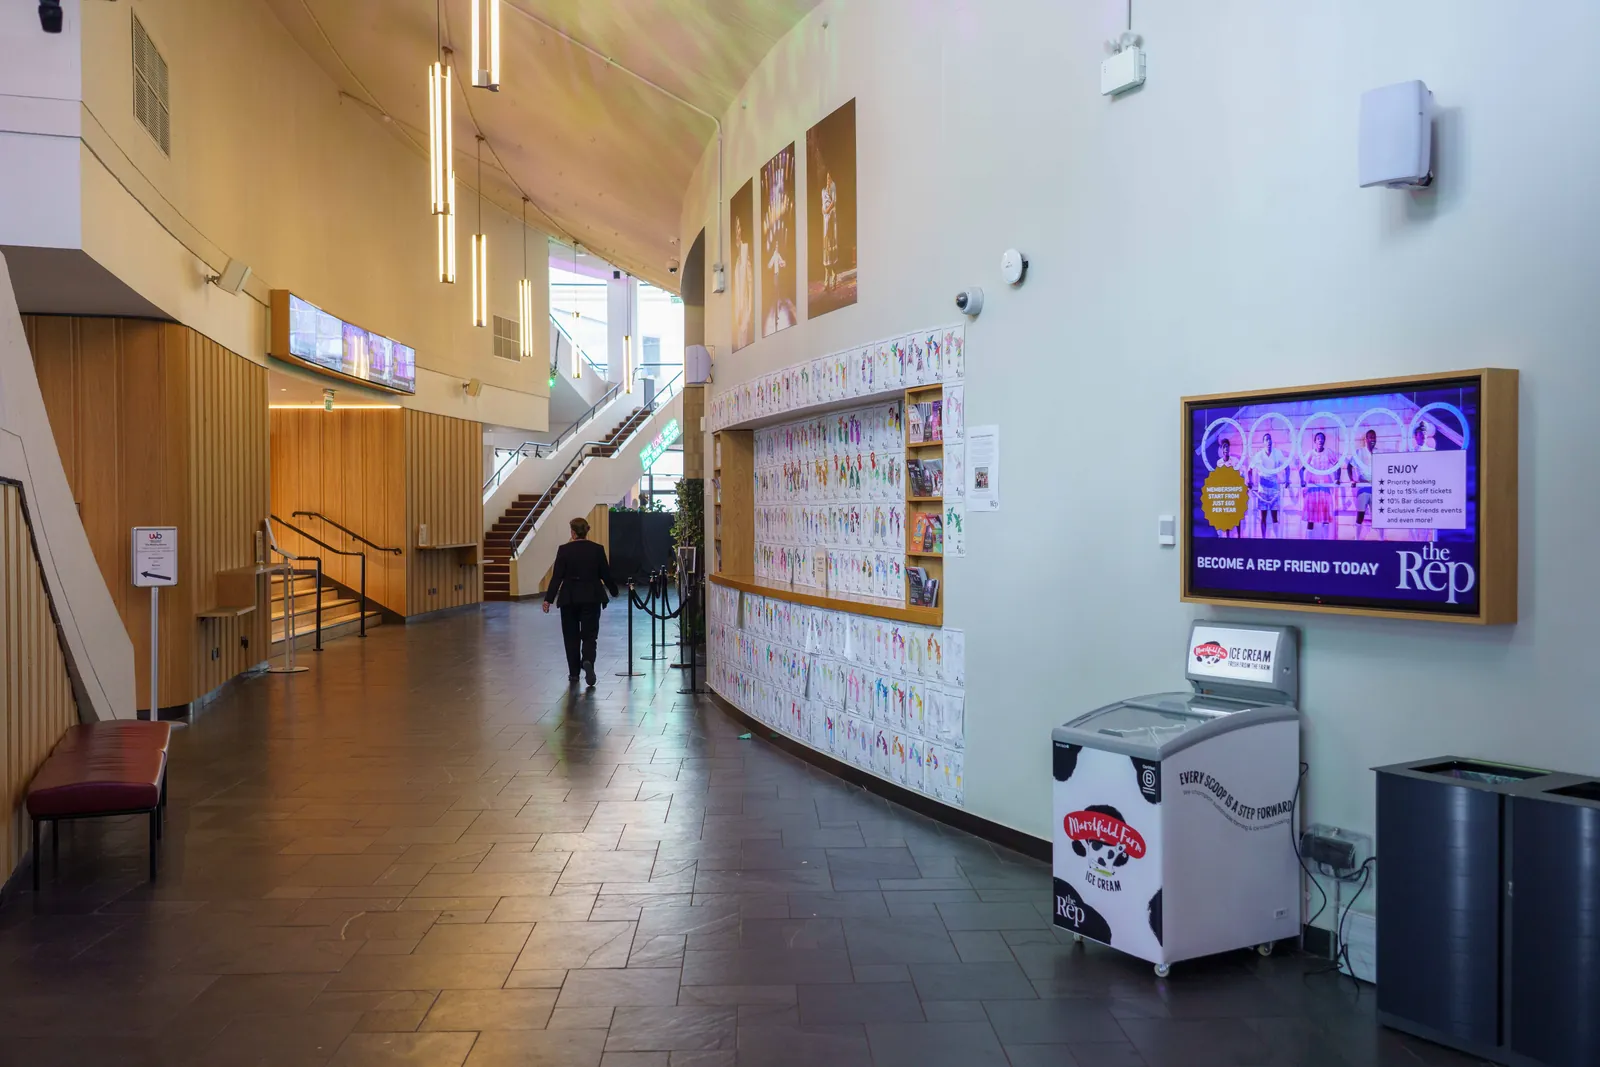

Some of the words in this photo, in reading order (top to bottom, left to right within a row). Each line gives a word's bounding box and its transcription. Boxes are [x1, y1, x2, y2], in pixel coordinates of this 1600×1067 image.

[651, 433, 664, 449] LOVE
[1387, 465, 1418, 474] ENJOY
[1422, 541, 1450, 561] the
[1197, 556, 1244, 570] BECOME
[1246, 558, 1255, 570] A
[1257, 558, 1281, 572] REP
[1284, 560, 1330, 574] FRIEND
[1332, 561, 1379, 575] TODAY
[1395, 550, 1475, 604] Rep
[1229, 647, 1241, 660] ICE
[1243, 649, 1271, 662] CREAM
[1145, 773, 1152, 784] B
[1179, 770, 1204, 785] EVERY
[1204, 775, 1227, 800] SCOOP
[1225, 794, 1233, 808] IS
[1231, 800, 1239, 813] A
[1238, 804, 1255, 820] STEP
[1257, 800, 1292, 820] FORWARD
[1068, 816, 1118, 839] Marshfield
[1120, 826, 1142, 852] Farm
[1085, 871, 1096, 886] ICE
[1097, 878, 1122, 892] CREAM
[1066, 894, 1076, 906] the
[1056, 895, 1085, 927] Rep
